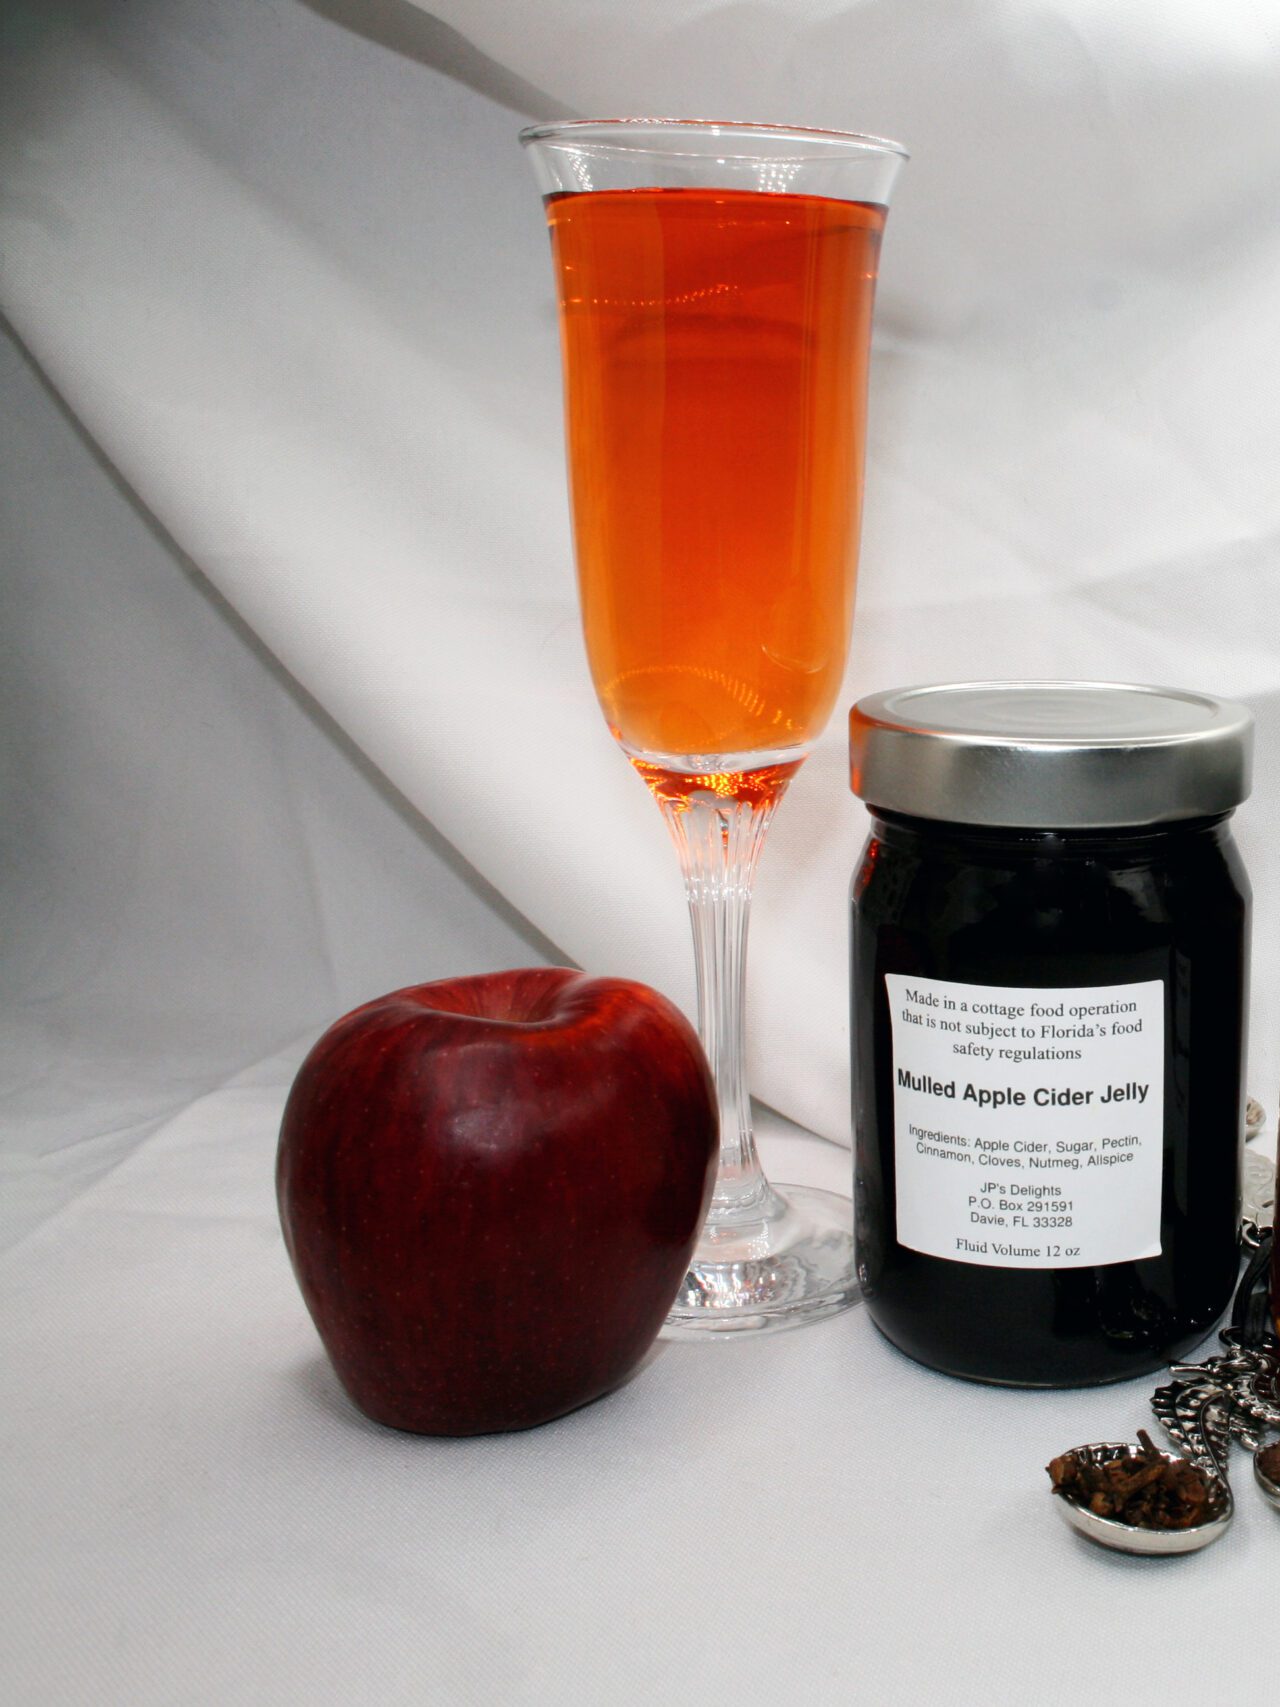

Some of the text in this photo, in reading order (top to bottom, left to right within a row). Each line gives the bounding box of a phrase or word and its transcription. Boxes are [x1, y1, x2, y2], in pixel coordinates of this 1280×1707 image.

[905, 988, 1137, 1020] Made in a cottage food operation
[902, 1008, 923, 1025] that
[926, 1014, 936, 1028] is
[940, 1020, 961, 1032] not
[965, 1022, 1016, 1040] subject
[1021, 1027, 1035, 1038] to
[1112, 1018, 1142, 1035] food
[953, 1042, 1082, 1063] safety regulations
[897, 1067, 1149, 1109] Mulled Apple Cider Jelly
[909, 1124, 1141, 1154] Ingredients: Apple Cider, Sugar, Pectin,
[916, 1141, 1134, 1170] Cinnamon, Cloves, Nutmeg, Allspice
[968, 1196, 1072, 1212] P.O. Box 291591
[1010, 1184, 1062, 1199] Delights
[970, 1211, 1073, 1228] Davie, FL 33328
[956, 1238, 1080, 1257] Fluid Volume 12 oz
